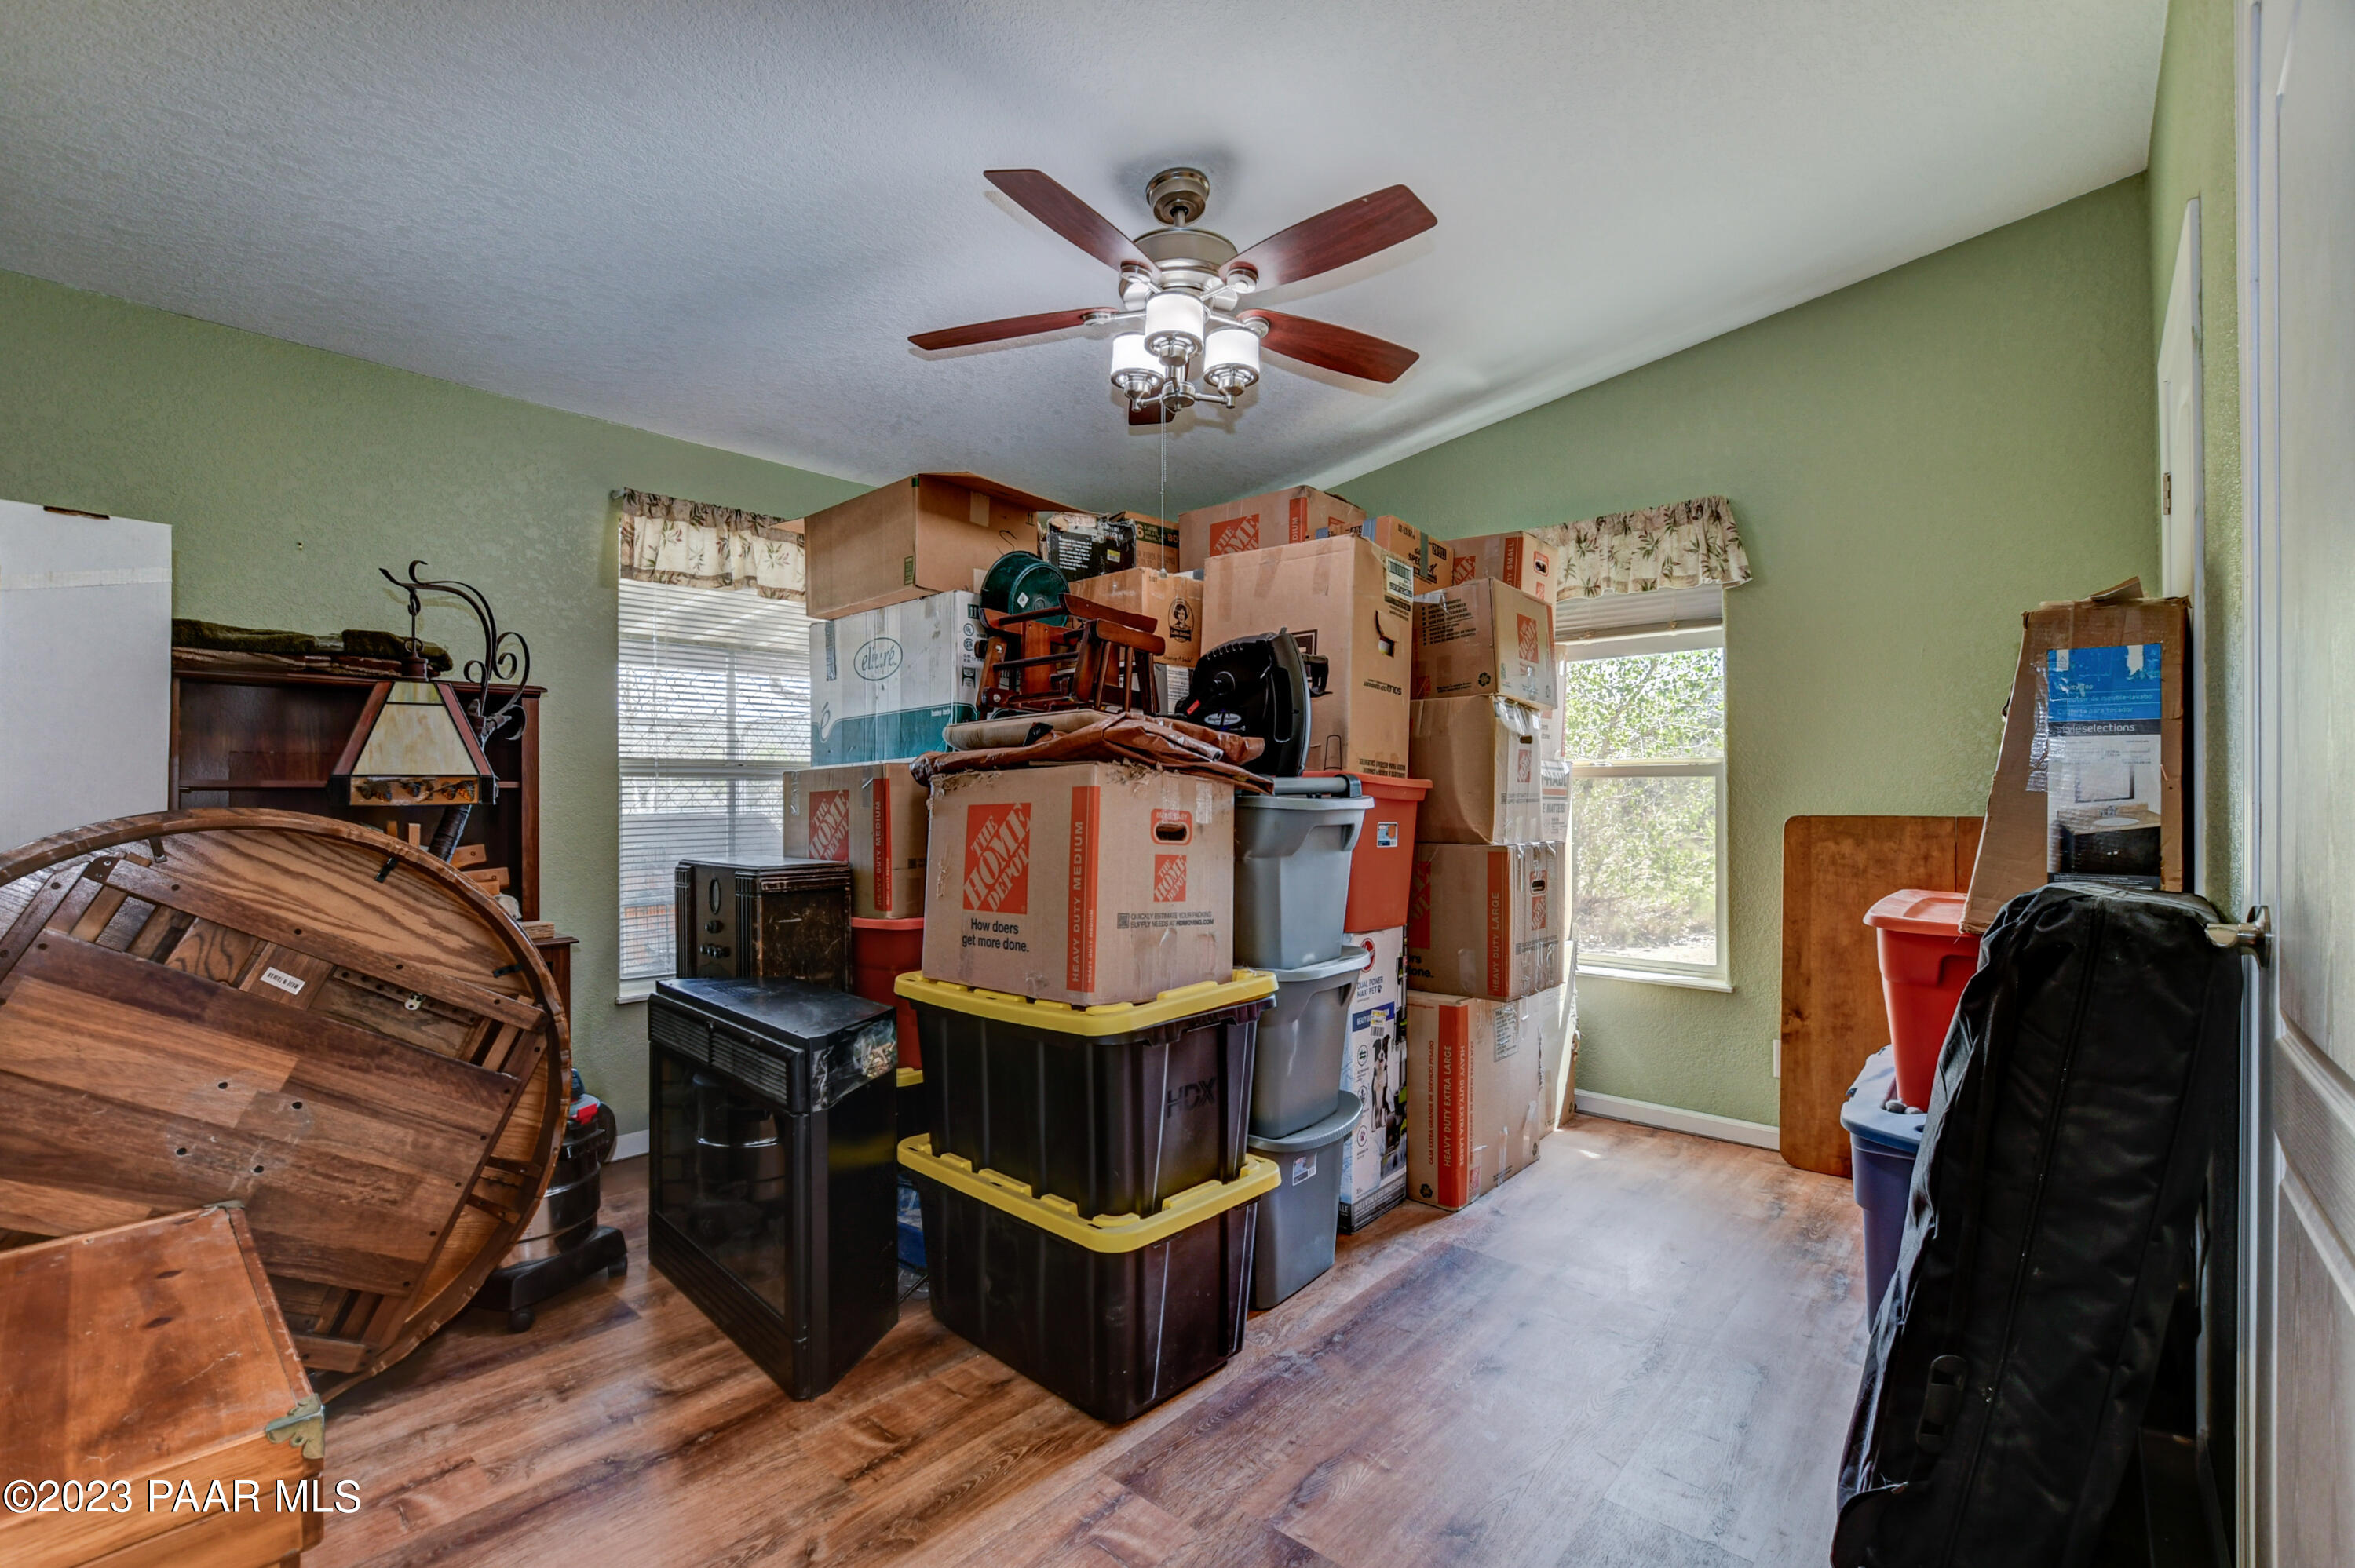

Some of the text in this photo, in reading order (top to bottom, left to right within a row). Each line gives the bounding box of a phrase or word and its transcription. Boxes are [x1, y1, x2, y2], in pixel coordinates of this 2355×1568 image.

[1214, 526, 1236, 551] THE
[1387, 684, 1402, 695] SOLO
[809, 789, 849, 859] HOME
[812, 798, 831, 826] THE
[823, 816, 849, 861] DEPOT
[969, 814, 999, 858] THE
[962, 802, 1031, 912] HOME
[1158, 859, 1171, 878] THE
[985, 842, 1031, 913] DEPOT
[1153, 855, 1188, 902] HOME
[1166, 872, 1188, 902] DEPOT
[1072, 821, 1083, 983] HEAVY DUTY MEDIUM
[1492, 892, 1500, 931] LARGE
[970, 917, 1019, 935] How doers
[962, 933, 1030, 953] get more done.
[1356, 975, 1384, 990] DUAL POWER
[1407, 965, 1435, 979] one.
[1368, 986, 1378, 995] PET
[1167, 1076, 1217, 1118] HDX
